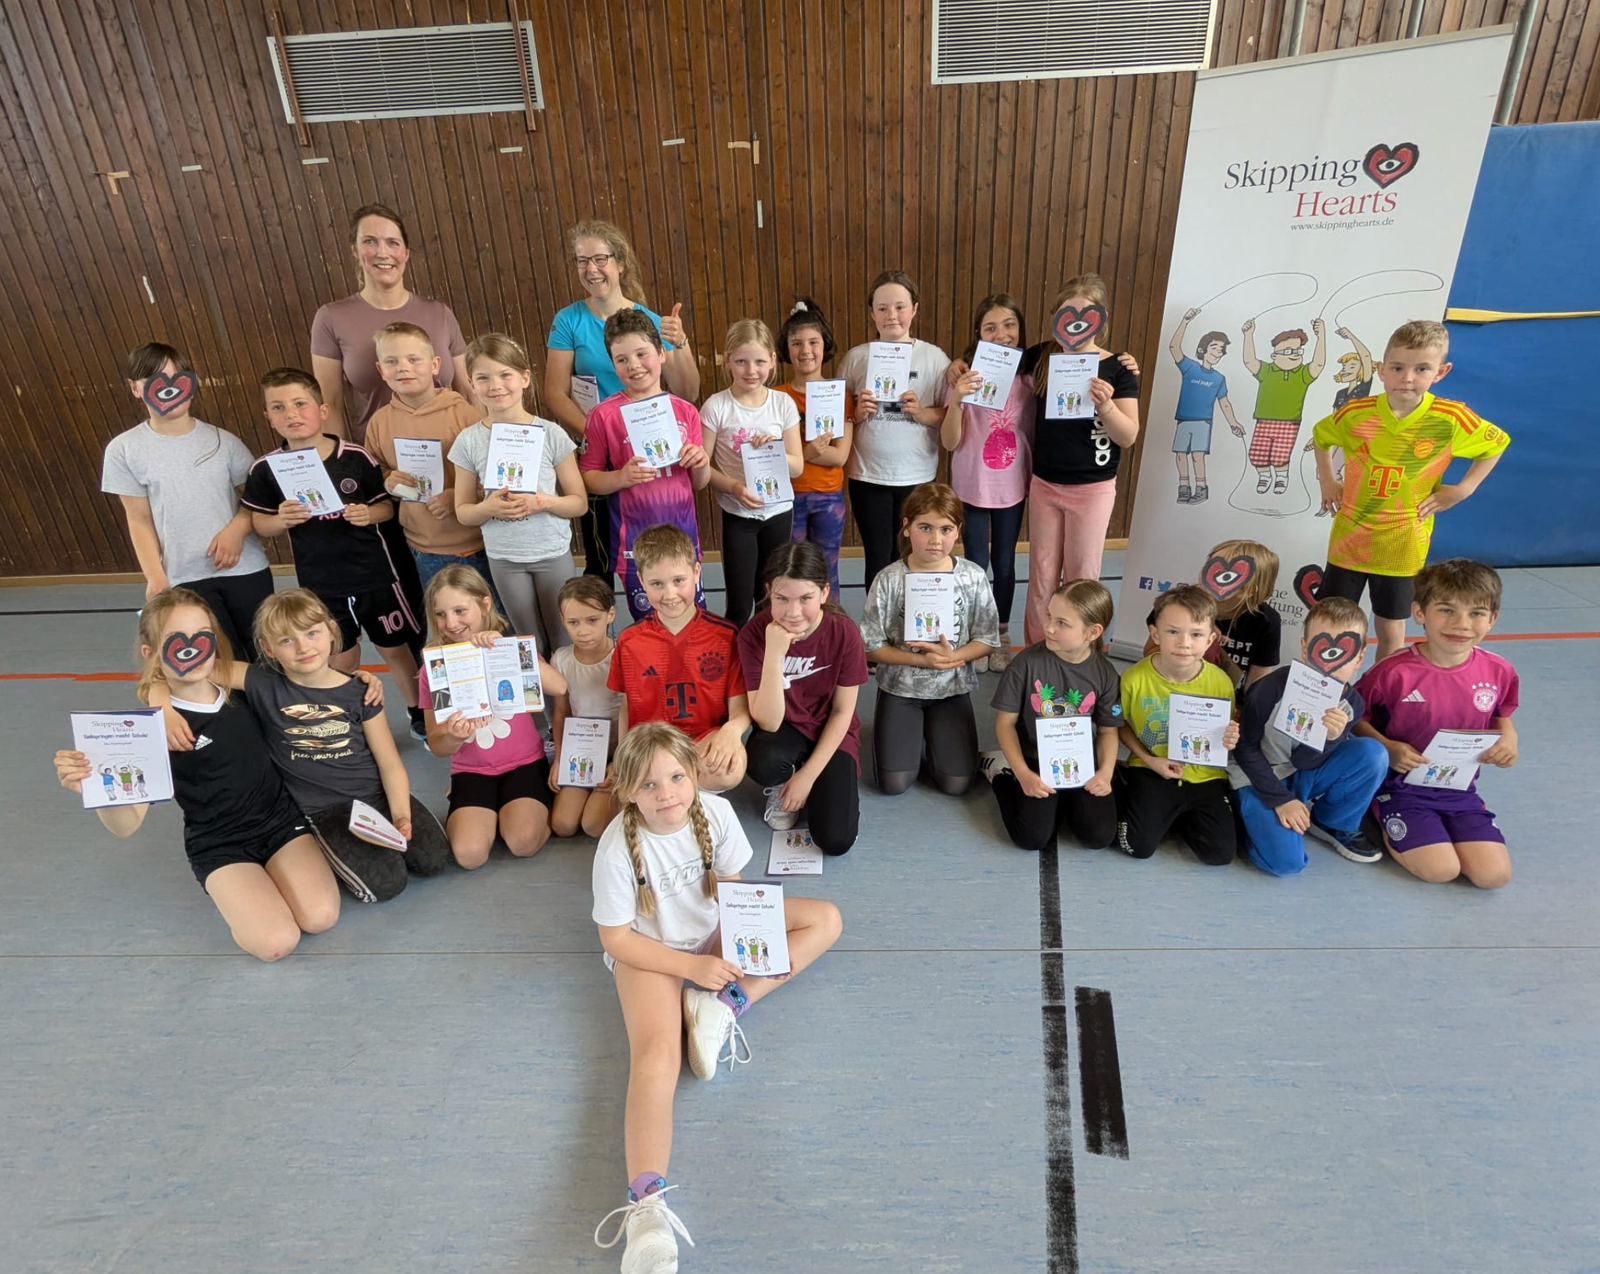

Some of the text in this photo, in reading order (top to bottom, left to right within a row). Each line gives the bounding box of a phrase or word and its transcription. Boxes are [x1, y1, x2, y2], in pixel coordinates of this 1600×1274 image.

[1224, 155, 1361, 194] Skipping
[1293, 190, 1398, 218] Hearts
[1290, 218, 1394, 231] www.skippinghearts.de
[378, 610, 404, 635] 10
[782, 656, 816, 674] NIKE
[665, 682, 697, 720] T
[92, 720, 124, 728] Skipping
[290, 750, 310, 760] free
[732, 889, 756, 898] Skipping
